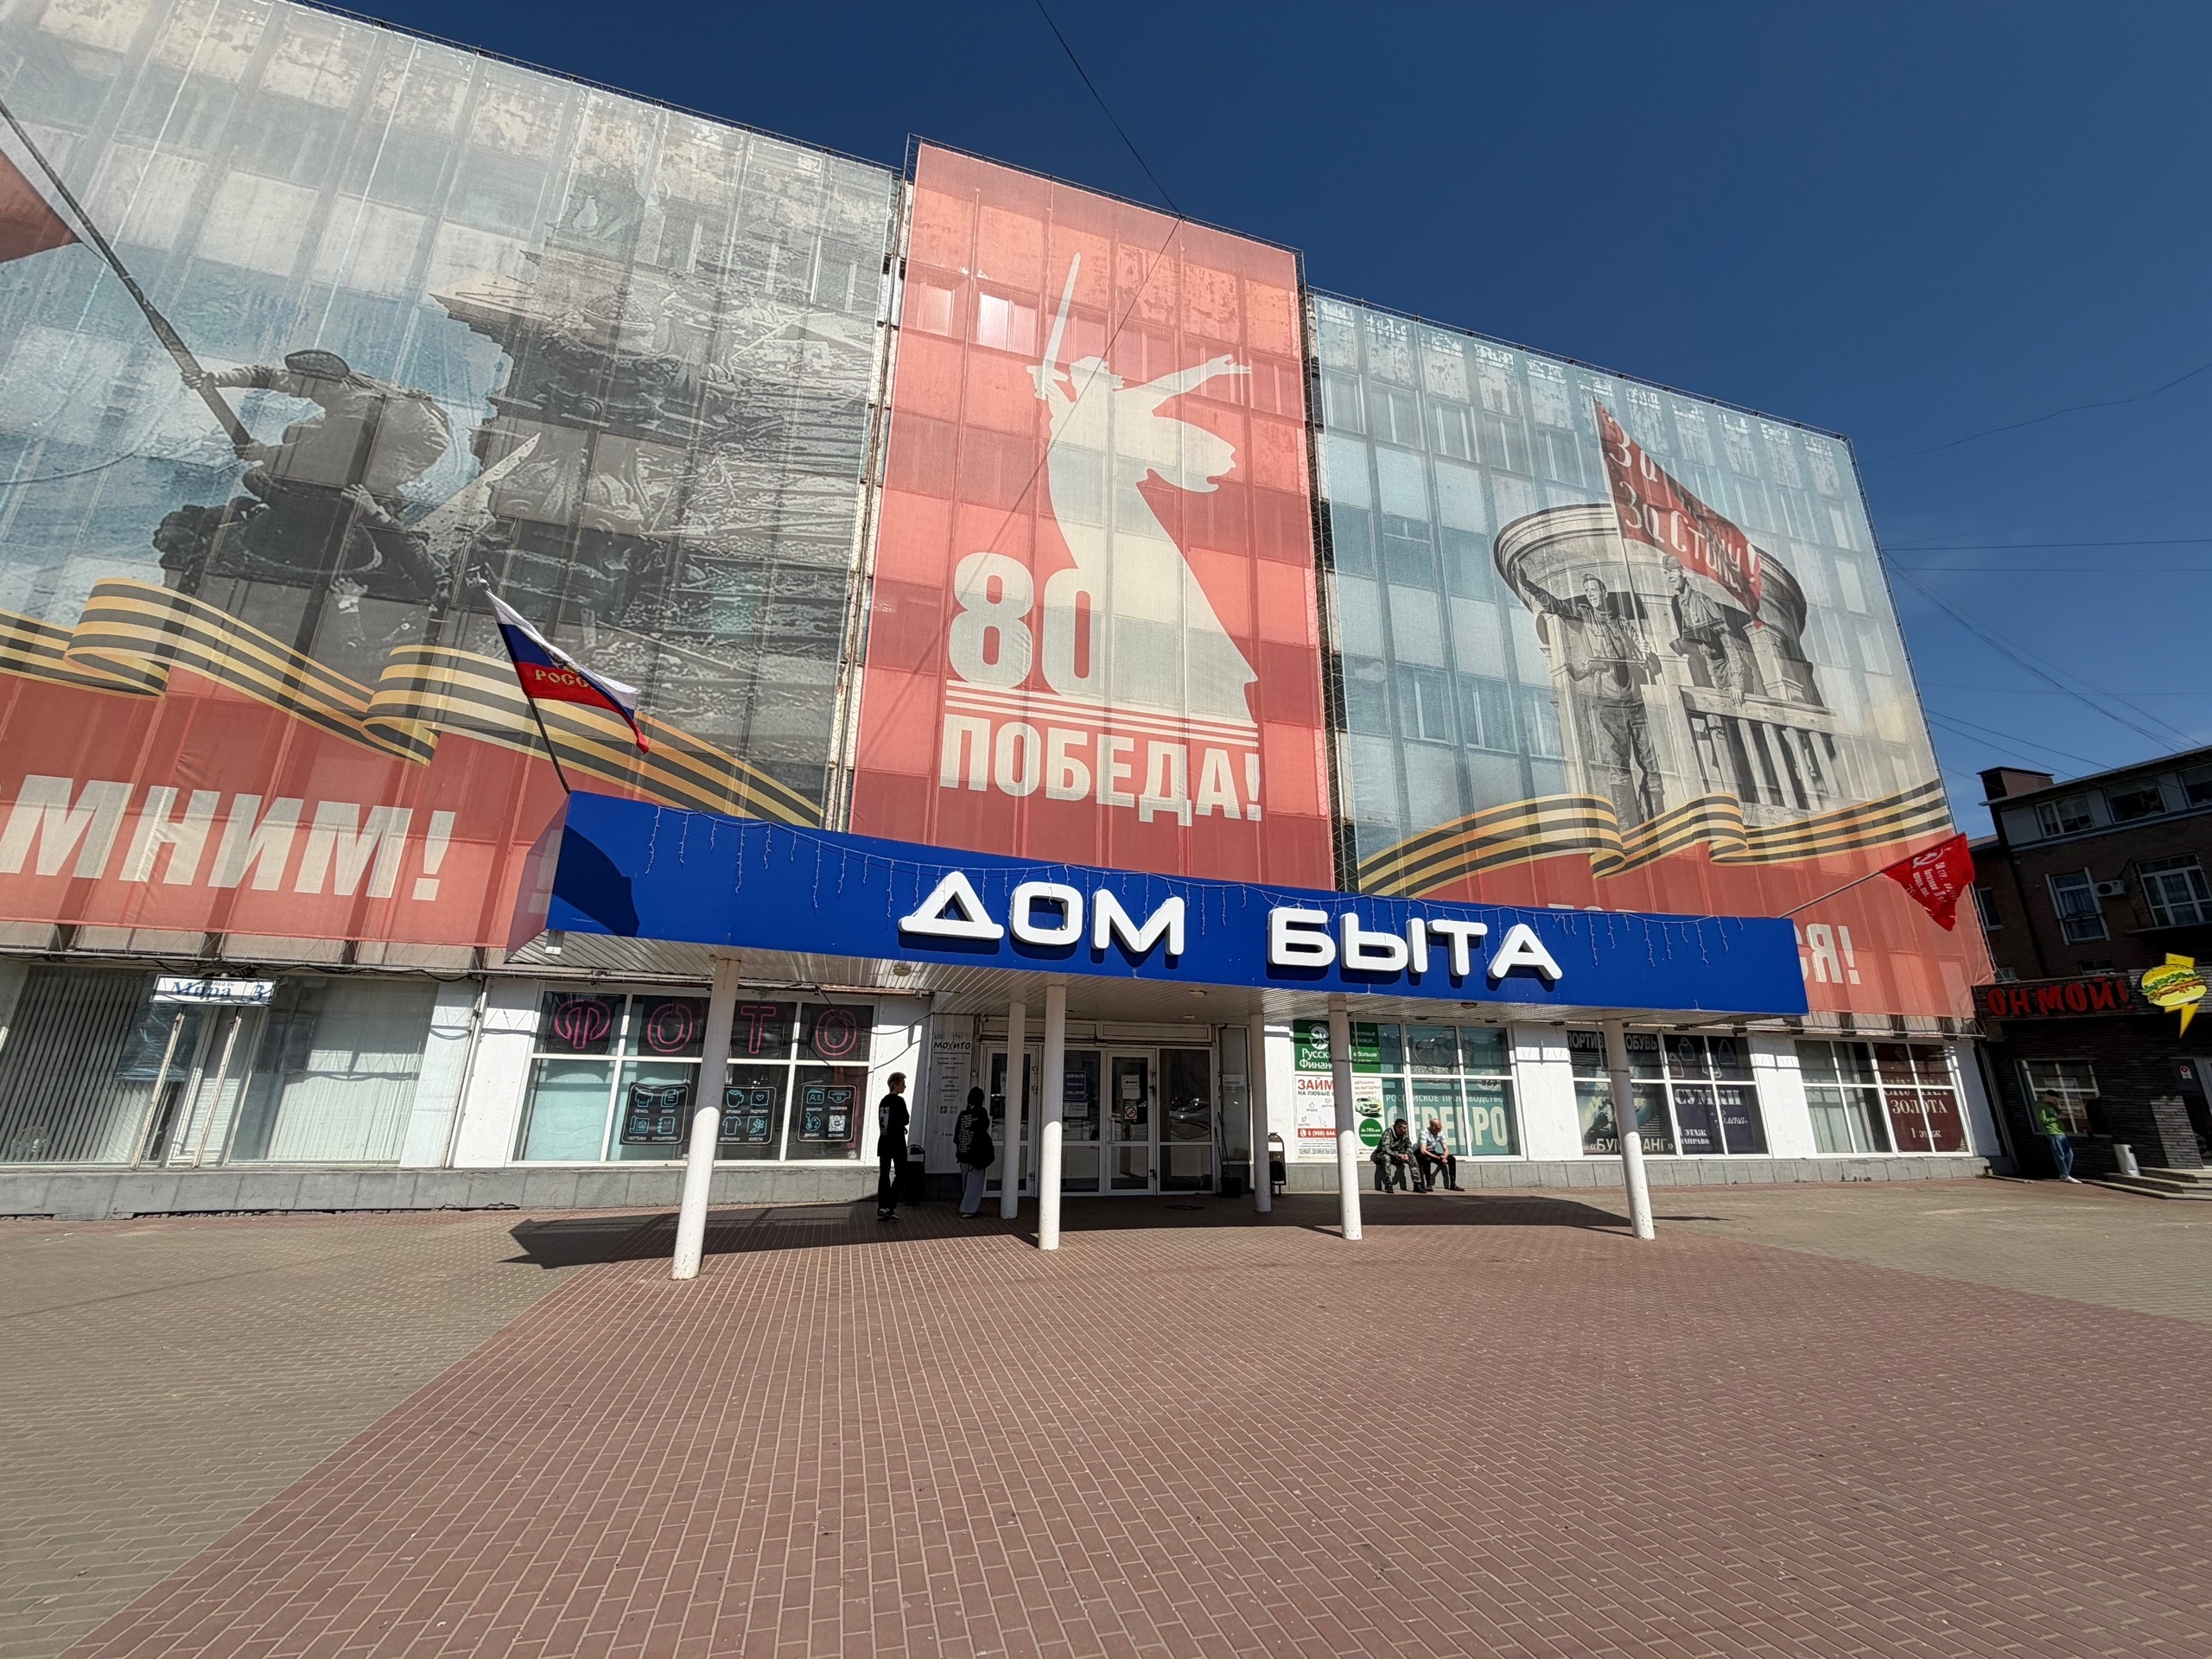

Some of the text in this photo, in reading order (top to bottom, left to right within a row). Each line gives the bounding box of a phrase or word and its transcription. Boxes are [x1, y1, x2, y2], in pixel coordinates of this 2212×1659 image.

[949, 551, 1123, 696] 80
[535, 670, 590, 688] РОСС
[939, 713, 1262, 827] ПОБЕДА!
[0, 774, 456, 900] МНИМ!
[898, 871, 1562, 980] ДОМ БЫТА
[173, 982, 232, 1001] Мира
[1987, 977, 2134, 1017] ОН МОЙ!
[554, 999, 857, 1057] ФОТО
[1625, 1034, 1657, 1051] ОБУВЬ
[1300, 1058, 1332, 1070] Финан
[1302, 1048, 1331, 1065] Русск
[1298, 1077, 1333, 1090] ЗАЙМ
